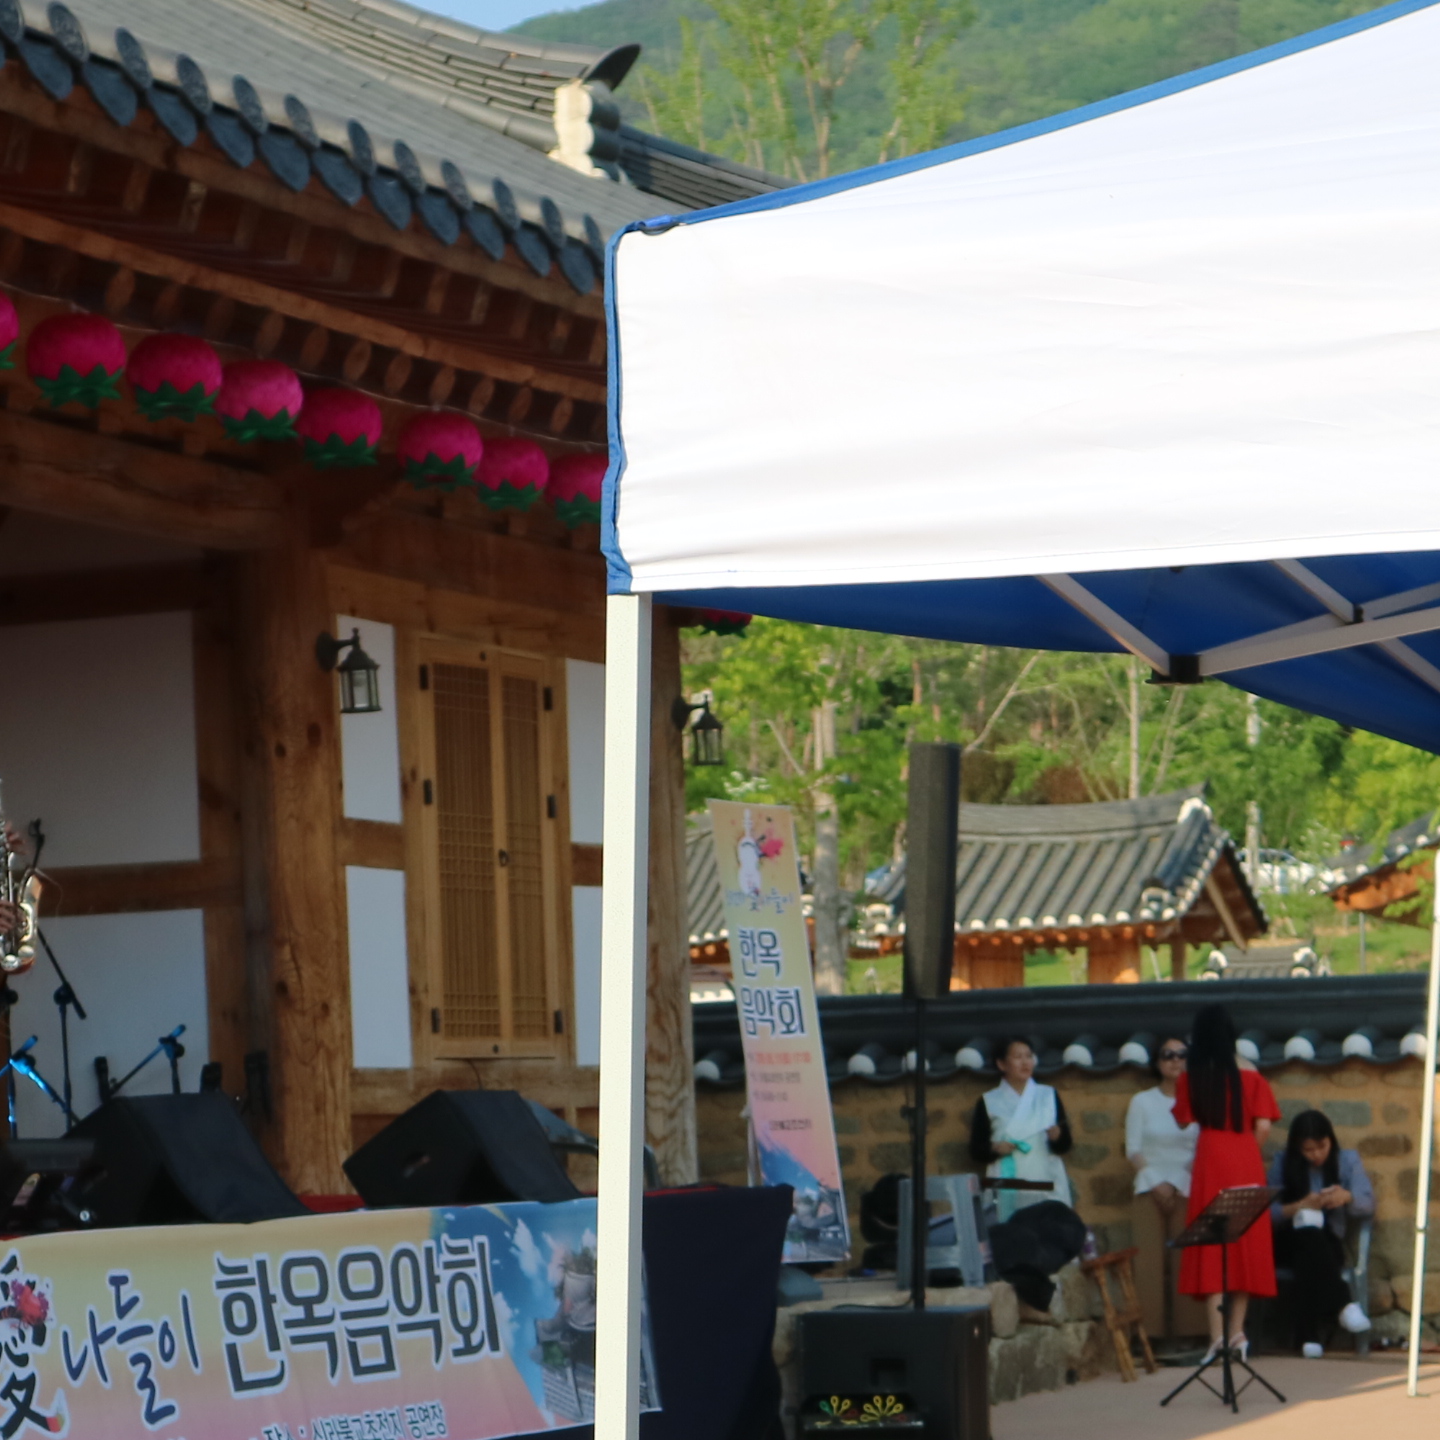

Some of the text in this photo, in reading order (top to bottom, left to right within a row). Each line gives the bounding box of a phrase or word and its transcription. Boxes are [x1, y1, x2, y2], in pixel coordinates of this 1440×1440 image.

[738, 929, 781, 977] 한옥
[741, 987, 805, 1036] 음악회
[62, 1274, 200, 1425] 나들이
[215, 1235, 501, 1393] 한옥음악회
[405, 1402, 447, 1439] 공연장
